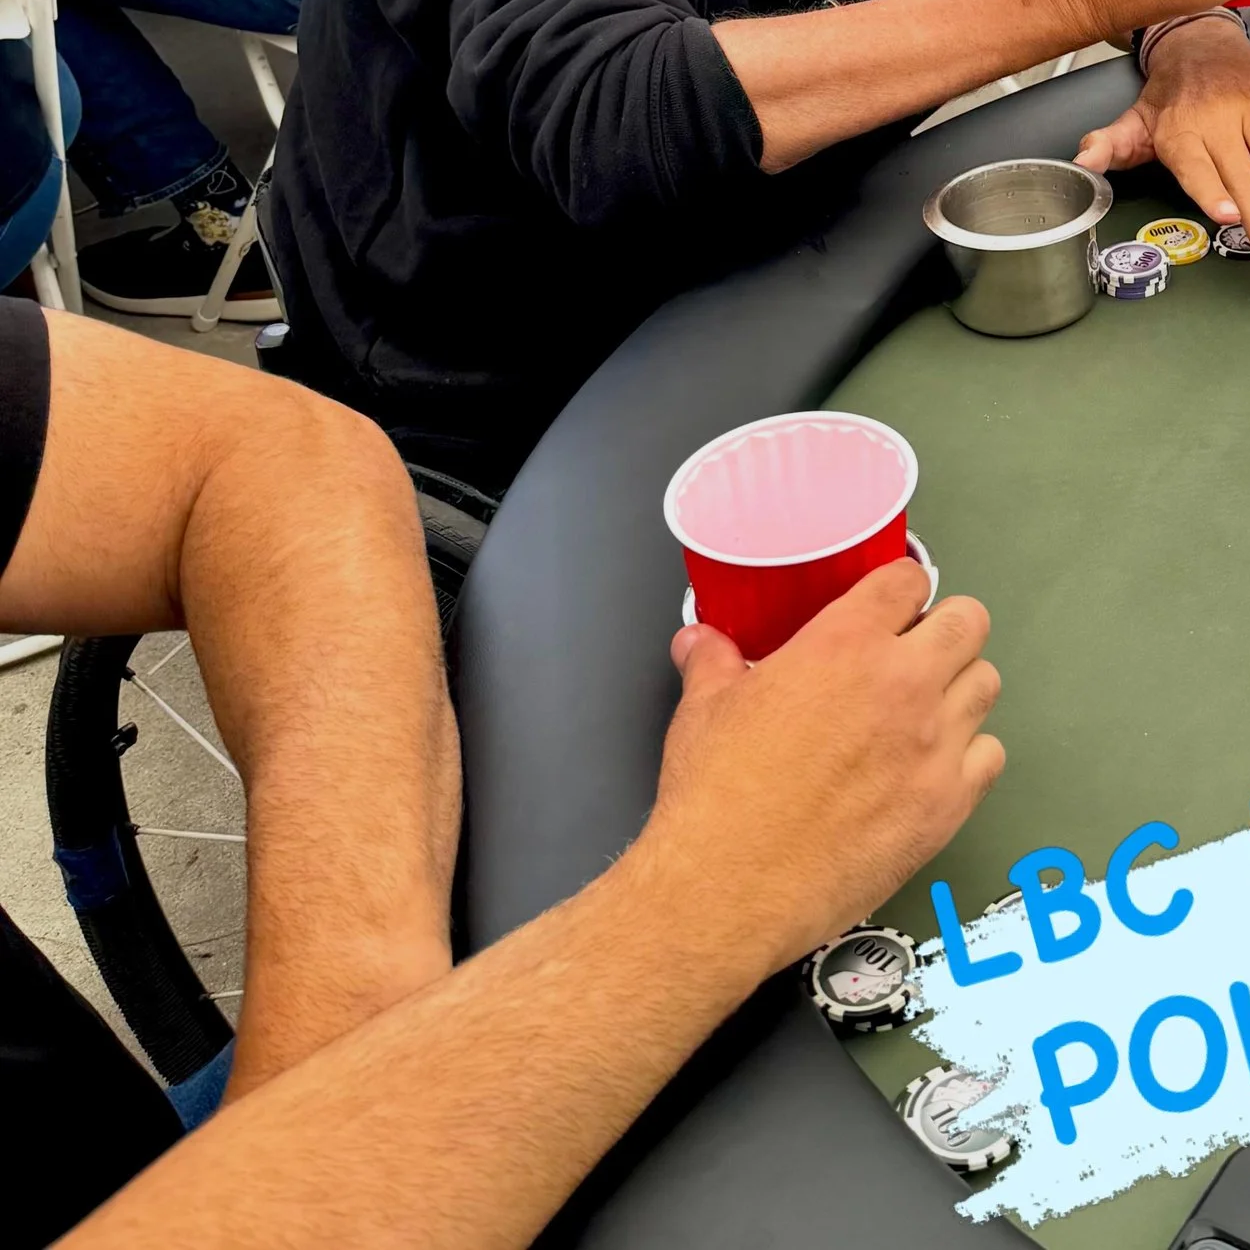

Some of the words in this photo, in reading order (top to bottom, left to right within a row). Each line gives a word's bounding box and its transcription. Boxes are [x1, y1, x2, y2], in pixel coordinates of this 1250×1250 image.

[1149, 224, 1180, 237] 1000
[1134, 251, 1158, 268] 500
[853, 937, 901, 973] 100
